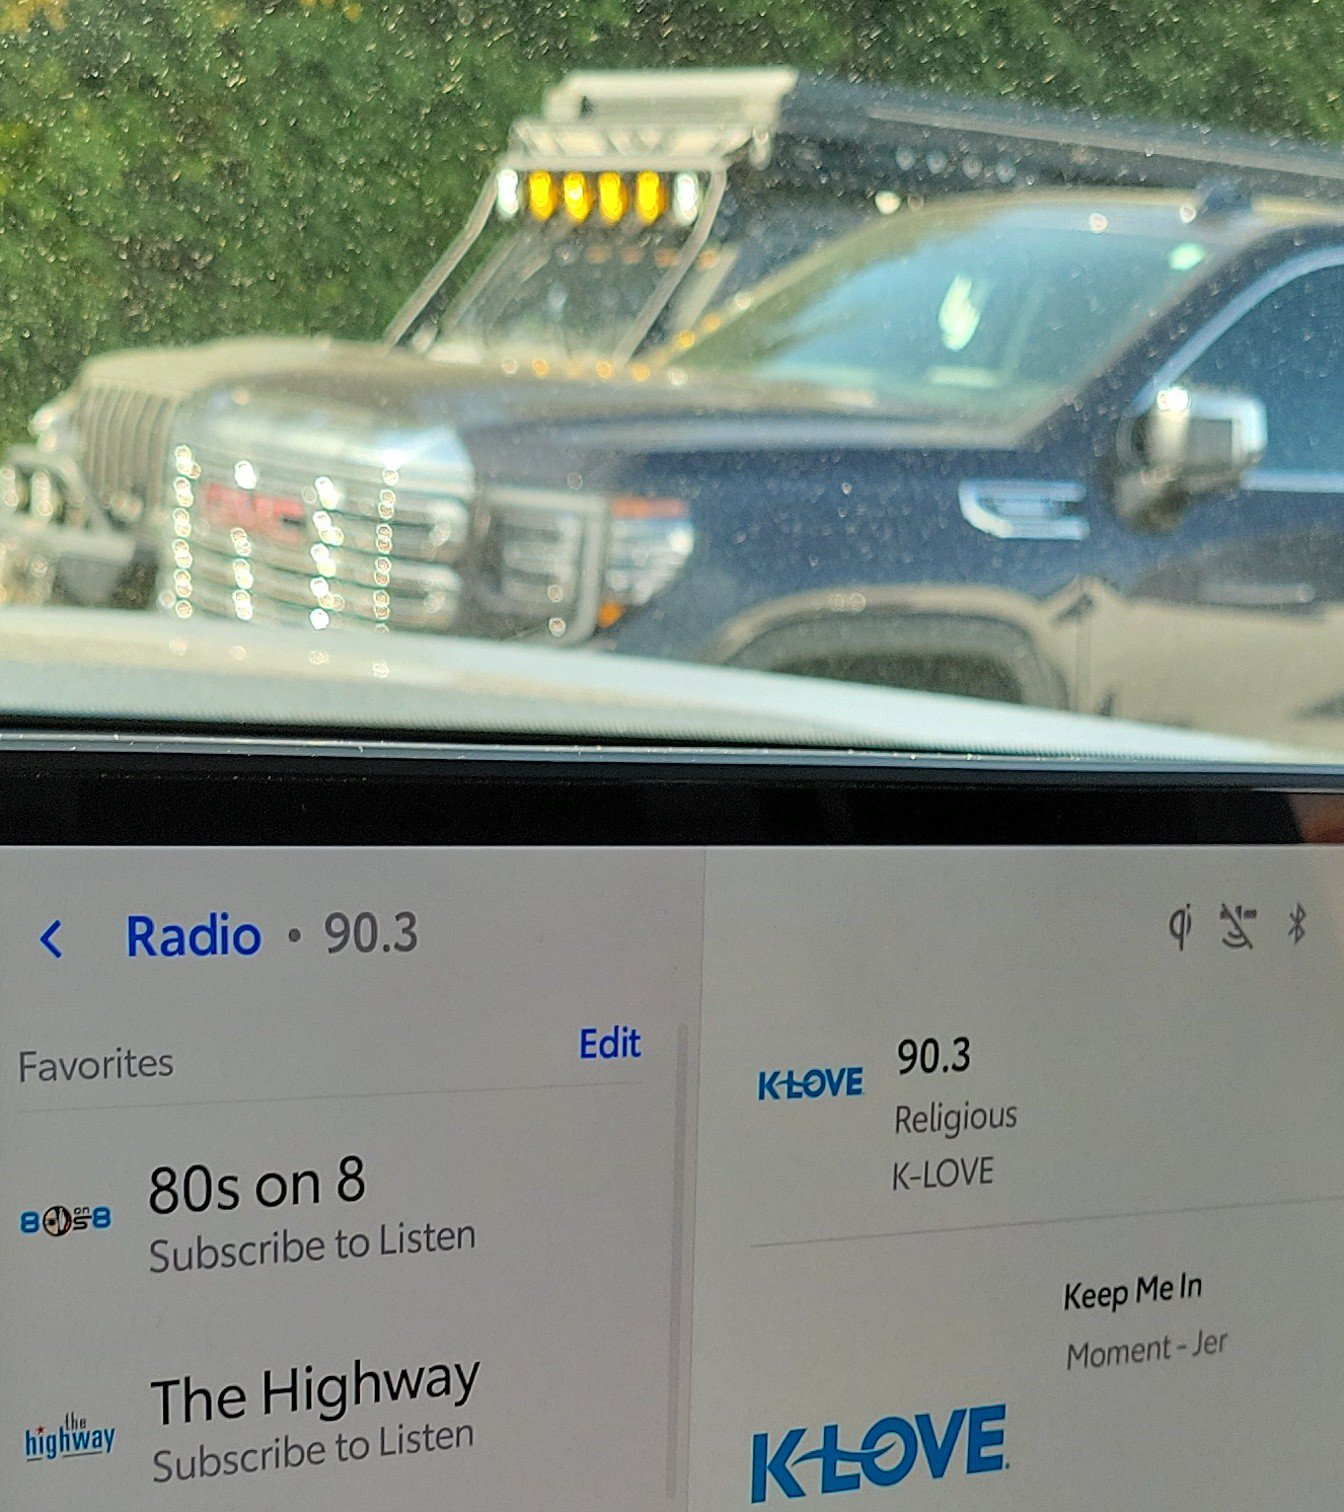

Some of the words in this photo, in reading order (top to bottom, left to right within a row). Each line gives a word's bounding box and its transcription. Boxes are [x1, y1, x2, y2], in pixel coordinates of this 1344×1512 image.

[128, 912, 260, 956] Radio
[325, 912, 417, 953] 90.3
[581, 1025, 641, 1058] Edit
[898, 1037, 969, 1075] 90.3
[20, 1047, 173, 1082] Favorites
[896, 1101, 1017, 1139] Religious
[150, 1165, 239, 1214] 80s
[255, 1170, 320, 1208] on
[338, 1156, 364, 1202] 8
[893, 1156, 993, 1190] K-LOVE
[150, 1228, 325, 1273] Subscribe
[335, 1230, 369, 1259] to
[381, 1222, 475, 1255] Listen
[1065, 1283, 1128, 1312] Keep
[1137, 1276, 1173, 1302] Me
[1181, 1273, 1202, 1298] In
[1067, 1336, 1170, 1370] Moment
[1192, 1330, 1228, 1357] Jer
[151, 1376, 246, 1425] The
[264, 1360, 480, 1421] Highway
[64, 1410, 87, 1431] the
[25, 1425, 116, 1460] highway
[154, 1436, 325, 1483] Subscribe
[335, 1434, 369, 1461] to
[381, 1424, 473, 1456] Listen
